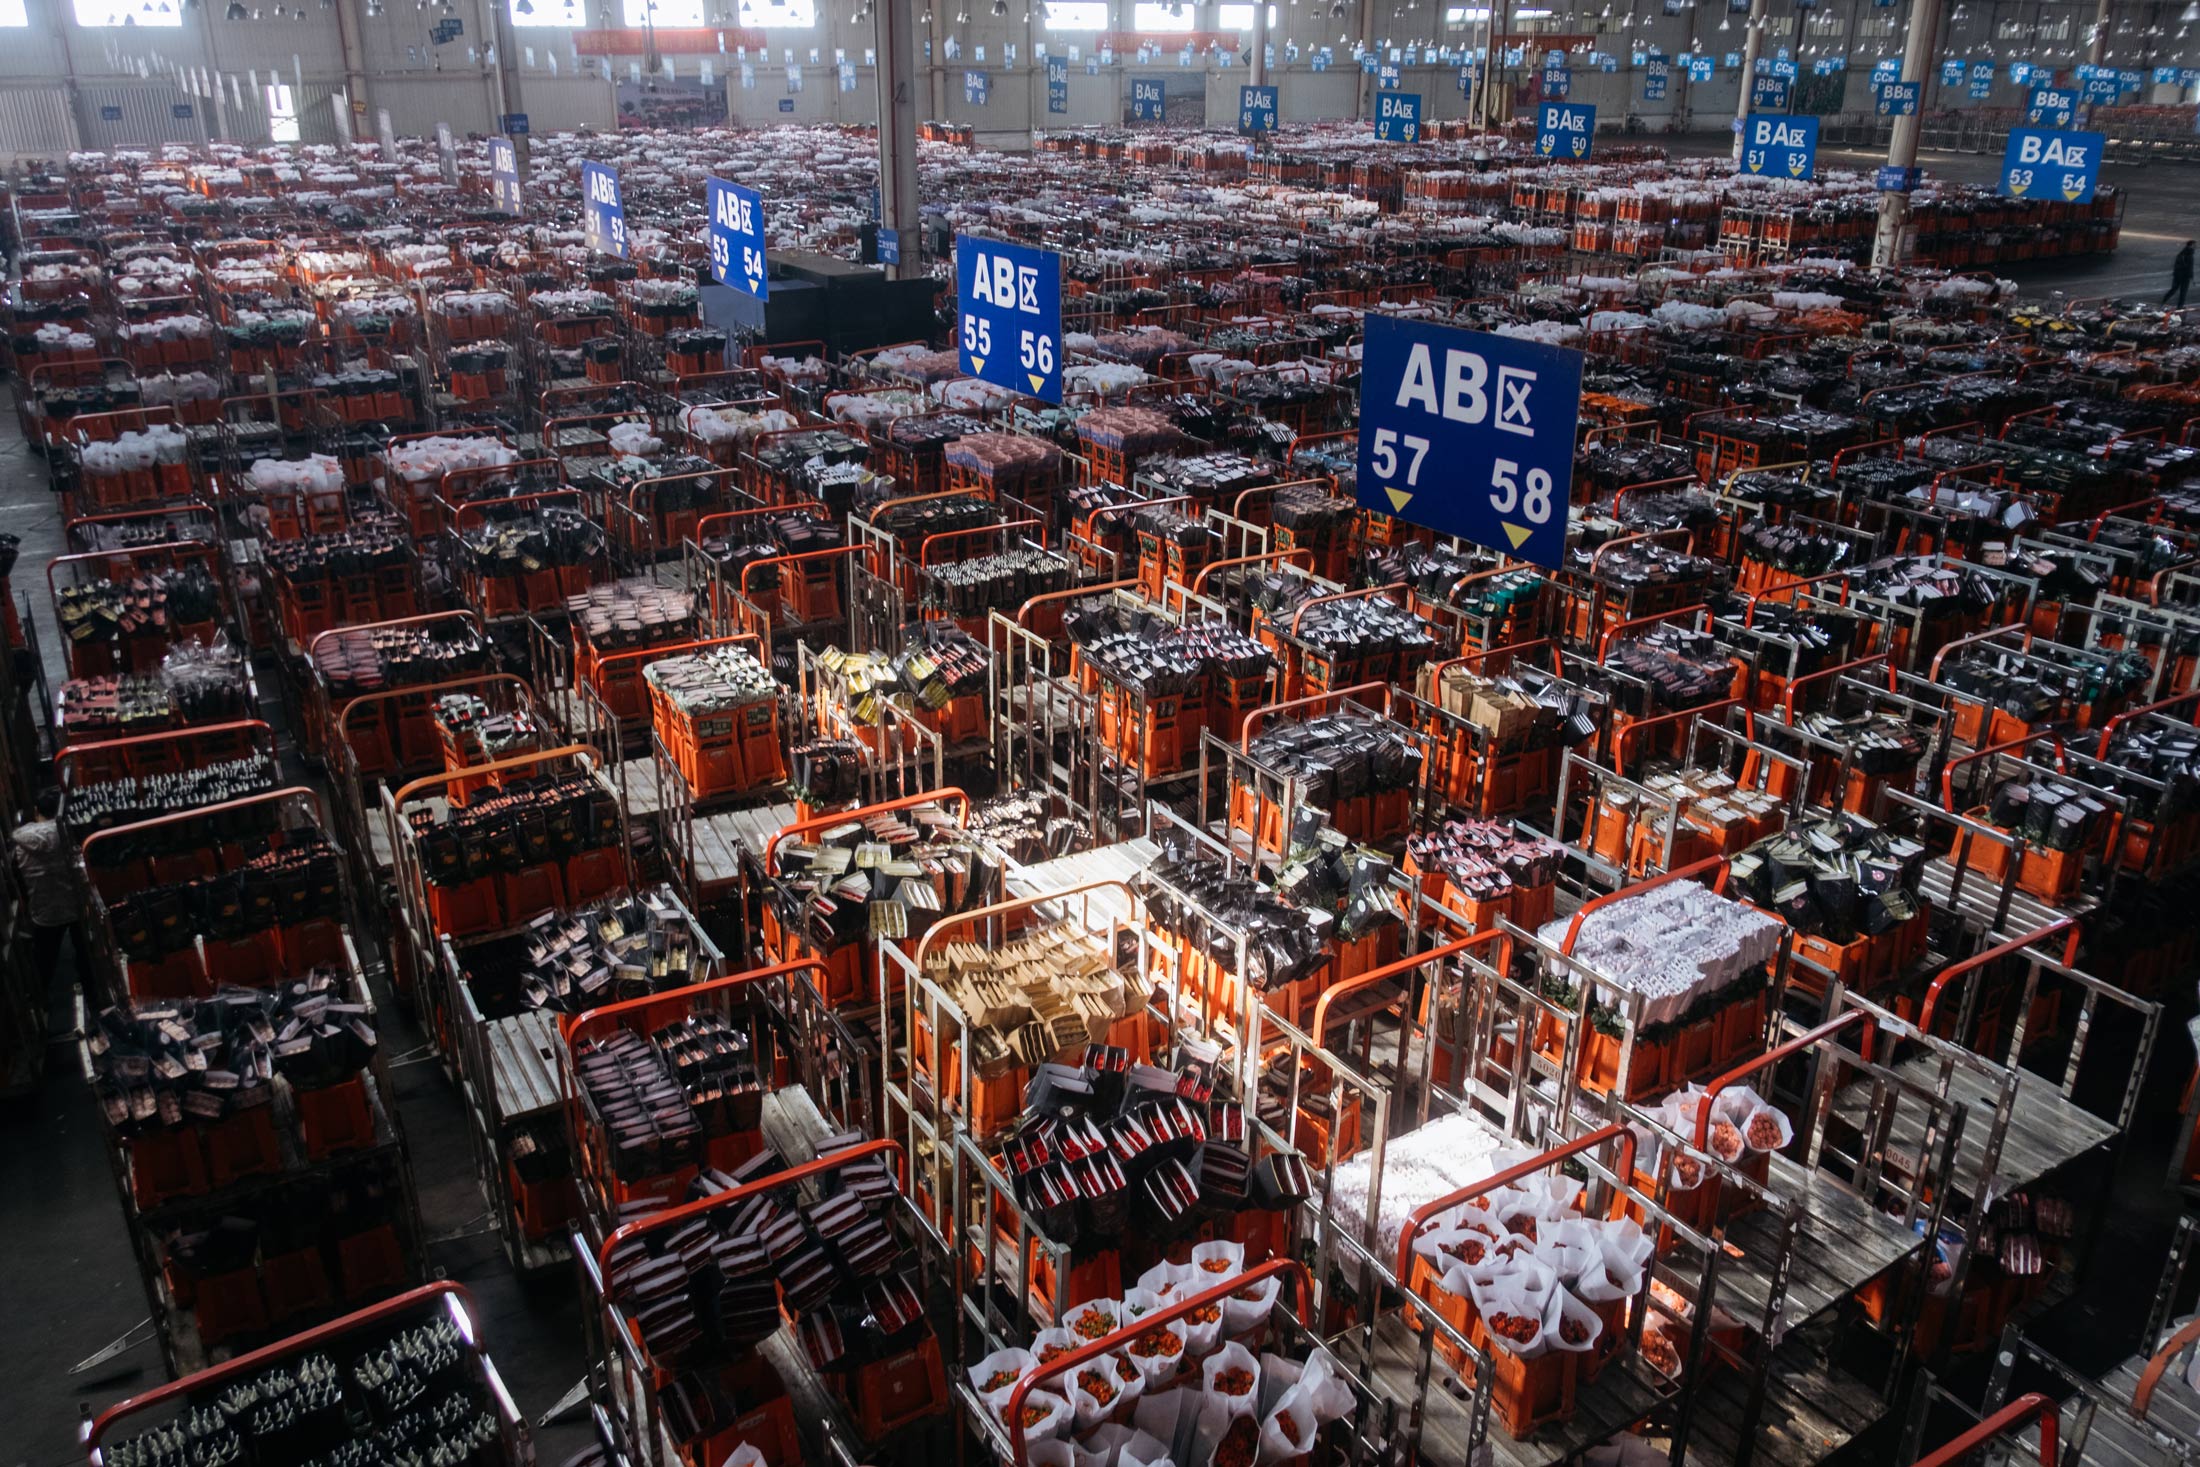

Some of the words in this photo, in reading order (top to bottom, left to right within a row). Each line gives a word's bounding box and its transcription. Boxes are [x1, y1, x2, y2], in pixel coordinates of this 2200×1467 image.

[1134, 103, 1143, 113] 43
[1152, 104, 1162, 113] 44
[1880, 102, 1890, 110] 45
[1903, 102, 1914, 111] 46
[2030, 109, 2043, 118] 47
[2056, 111, 2070, 121] 48
[1242, 112, 1252, 122] 45
[1263, 113, 1274, 123] 46
[1378, 122, 1390, 133] 47
[1403, 124, 1415, 135] 48
[1541, 134, 1555, 147] 49
[1572, 137, 1587, 150] 50
[1748, 150, 1765, 164] 51
[1788, 153, 1807, 168] 52
[2009, 169, 2034, 186] 53
[2062, 173, 2086, 191] 54
[588, 209, 600, 234] 51
[611, 216, 624, 242] 52
[713, 234, 729, 266] 53
[743, 246, 763, 280] 54
[965, 314, 991, 356] 55
[1020, 330, 1053, 374] 56
[1372, 428, 1430, 486] 57
[1489, 458, 1552, 524] 58
